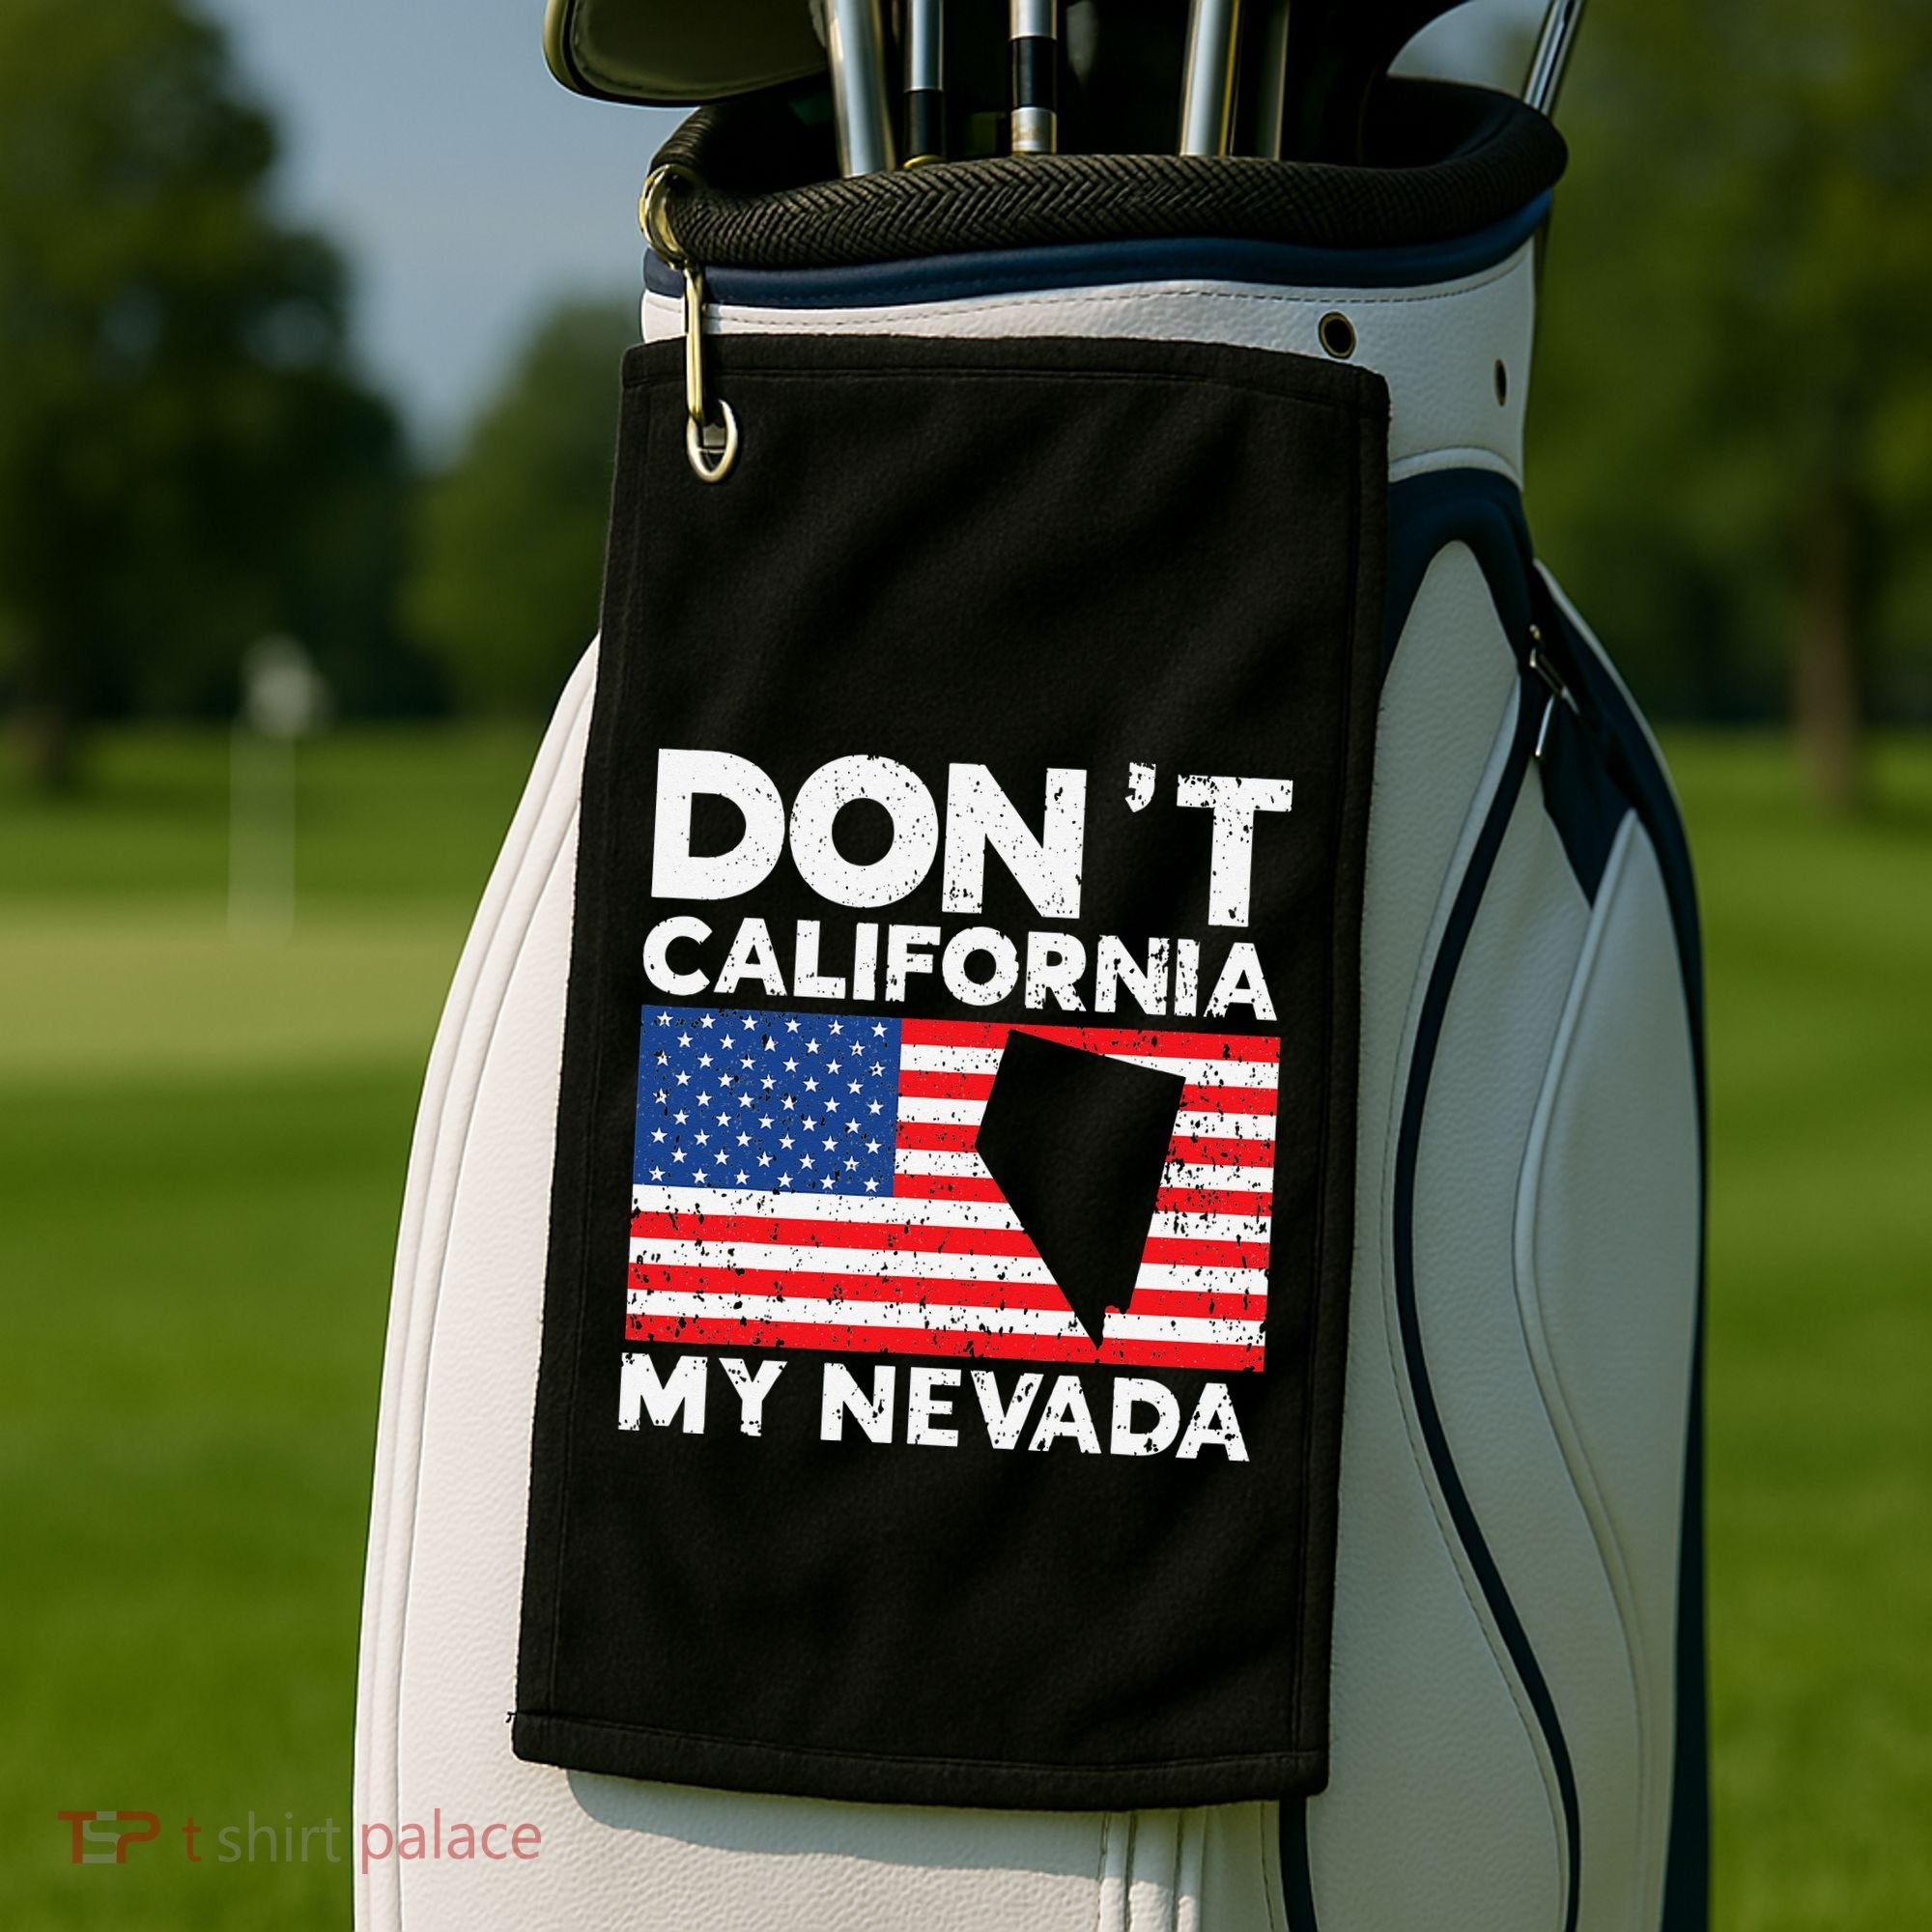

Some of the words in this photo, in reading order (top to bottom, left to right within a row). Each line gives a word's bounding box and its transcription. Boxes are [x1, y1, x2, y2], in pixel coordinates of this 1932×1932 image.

[642, 916, 1278, 1021] CALIFORNIA
[617, 1352, 788, 1437] MY
[820, 1362, 1250, 1463] NEVADA
